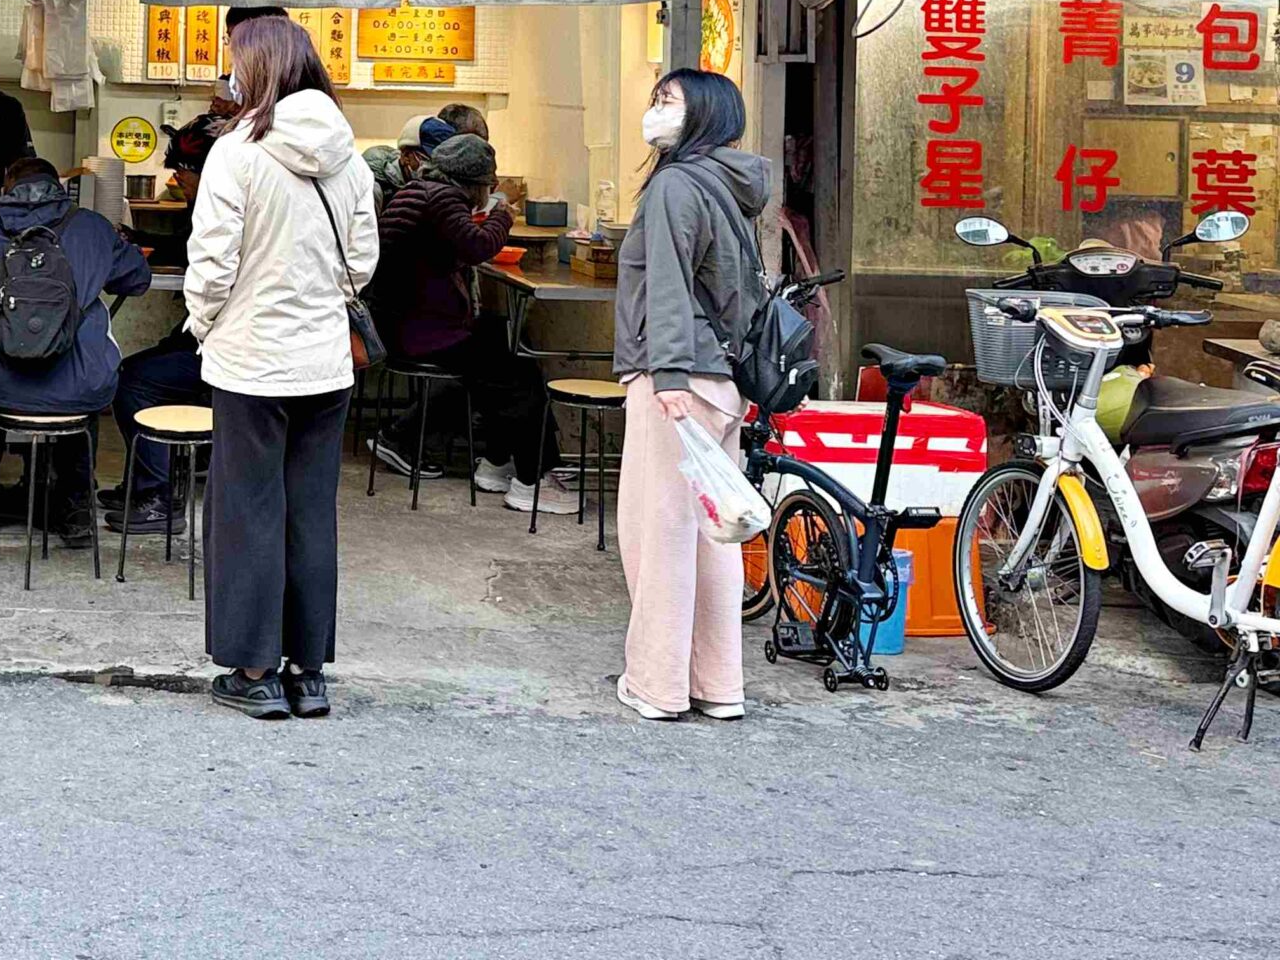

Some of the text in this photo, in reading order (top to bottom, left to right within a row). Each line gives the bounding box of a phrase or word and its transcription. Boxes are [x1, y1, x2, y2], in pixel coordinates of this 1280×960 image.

[373, 44, 459, 55] 14:00-19:30
[1175, 62, 1195, 83] 9
[1054, 0, 1123, 213] 菁仔
